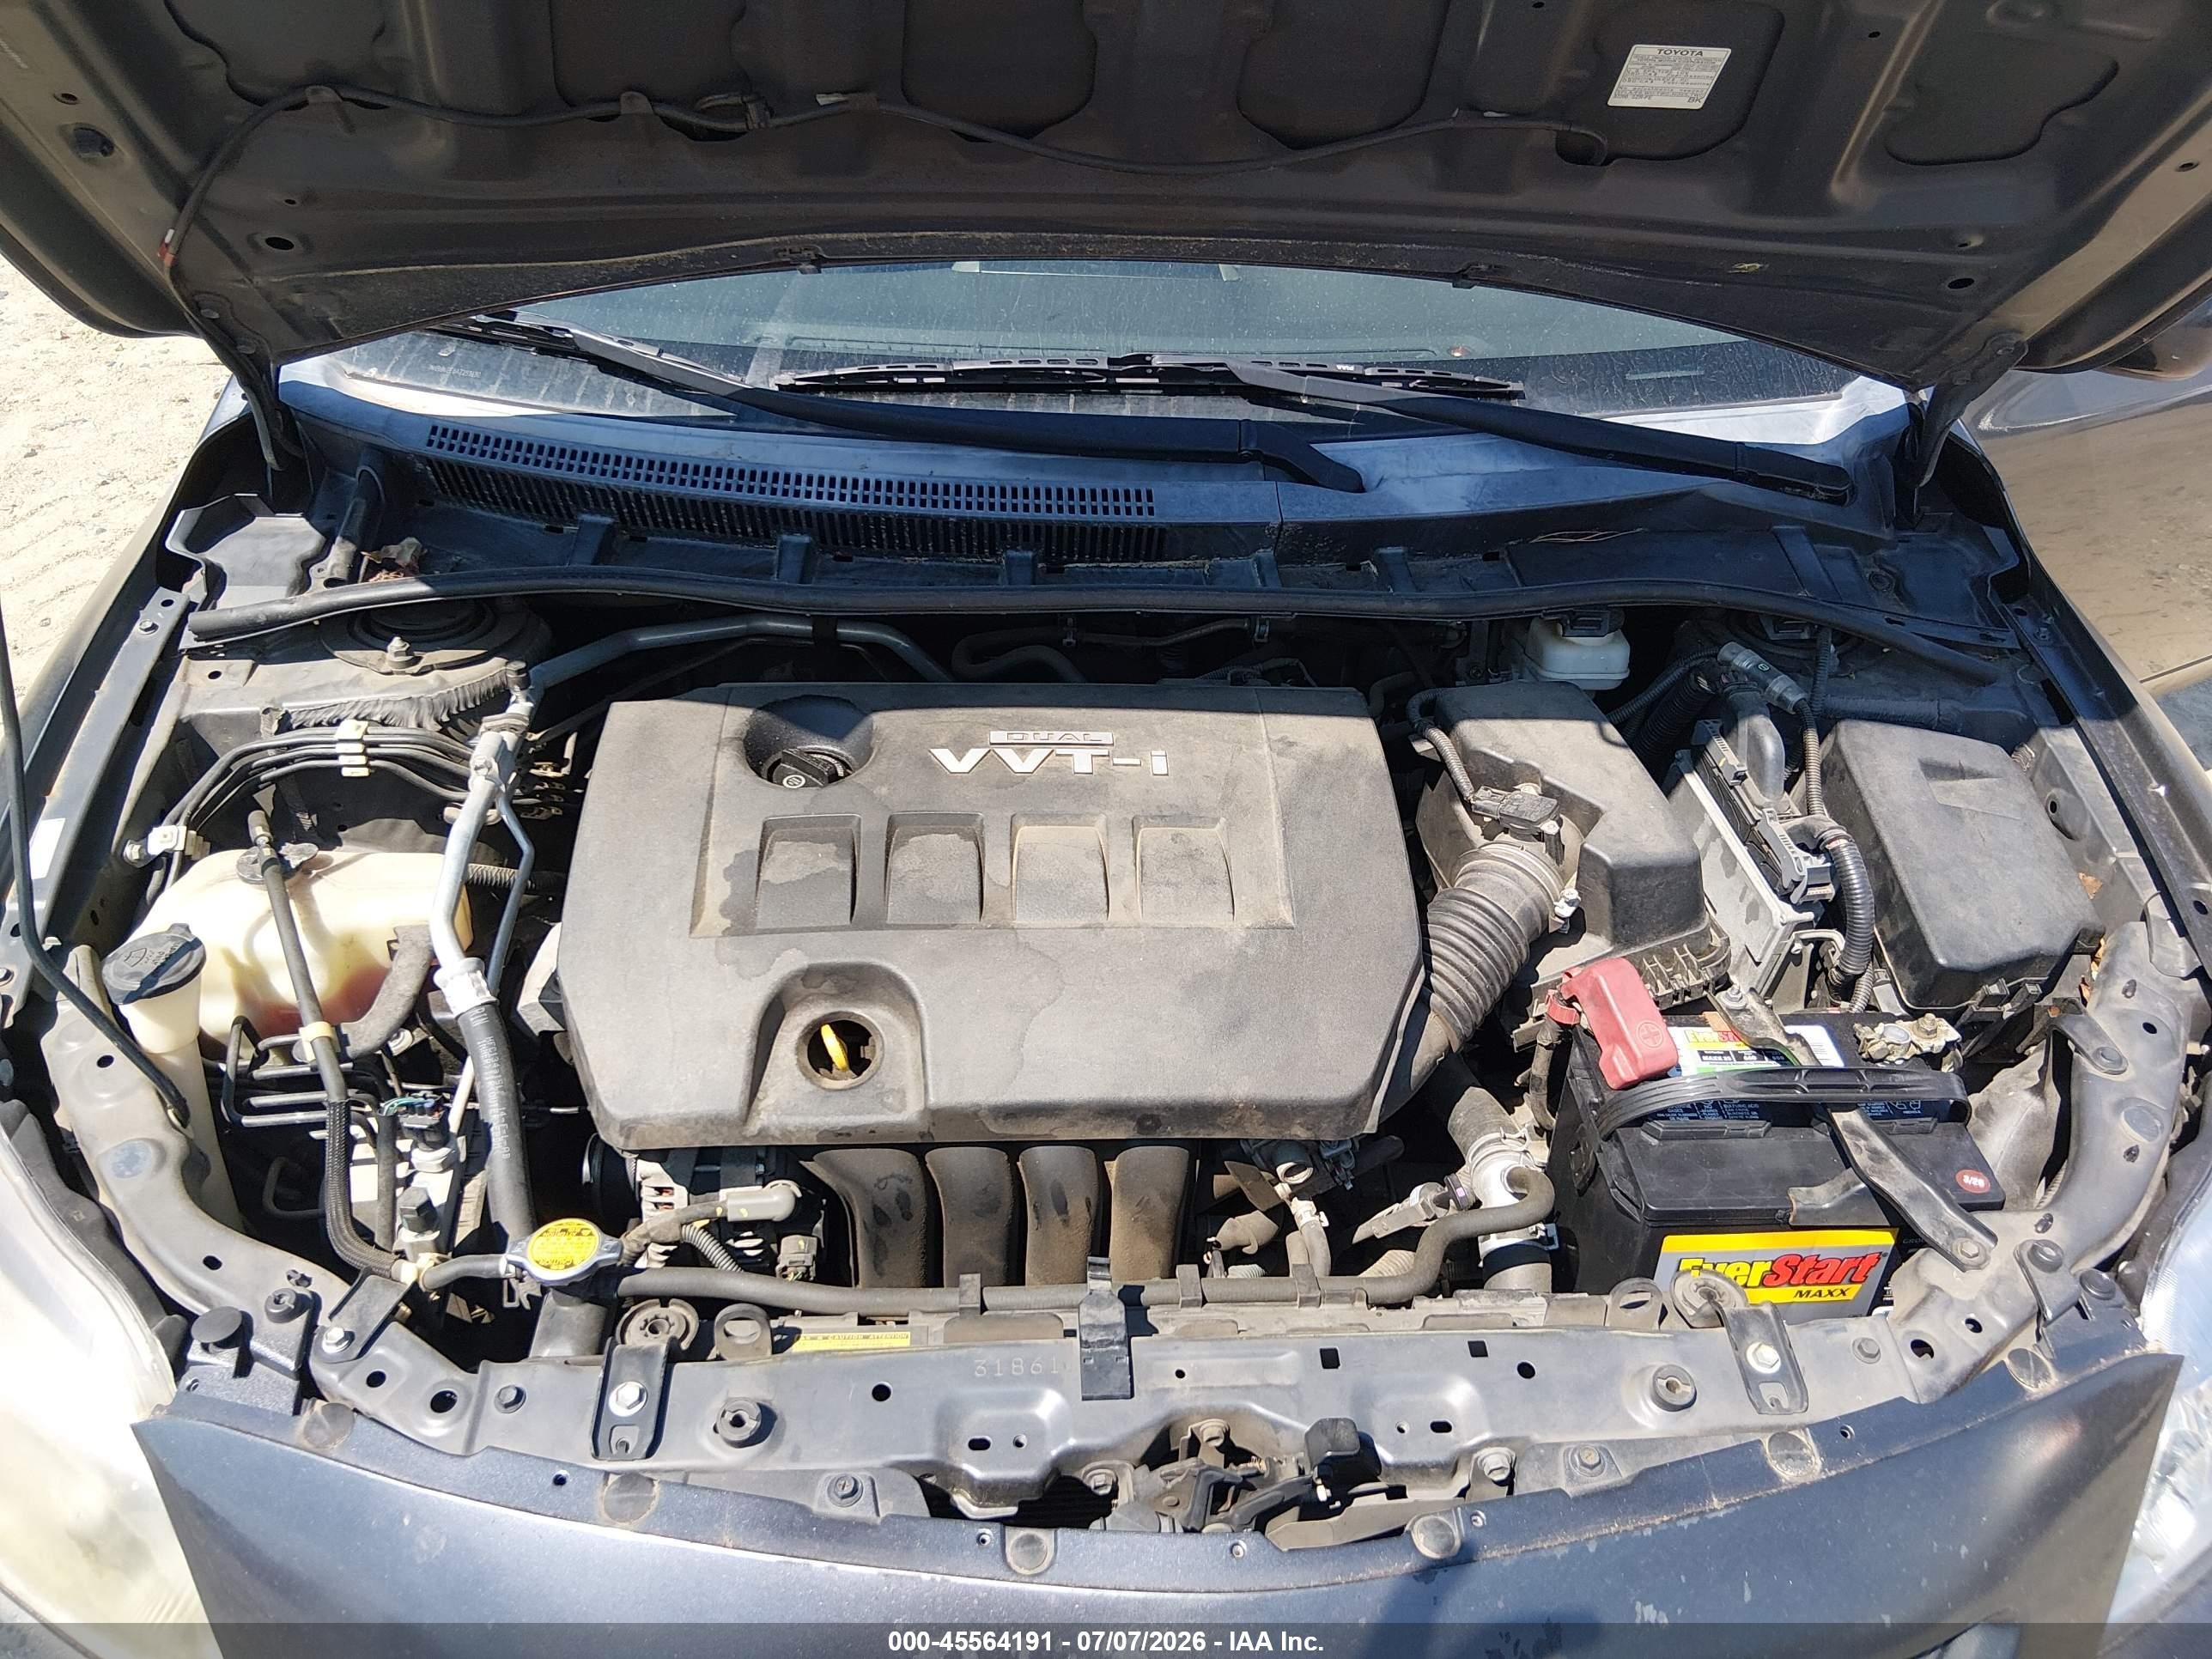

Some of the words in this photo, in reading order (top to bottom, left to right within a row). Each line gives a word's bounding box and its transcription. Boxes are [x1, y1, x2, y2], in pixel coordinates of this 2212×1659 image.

[1007, 732, 1103, 742] DUAL
[1794, 1288, 1852, 1299] MAXX
[975, 1356, 1059, 1377] 31861
